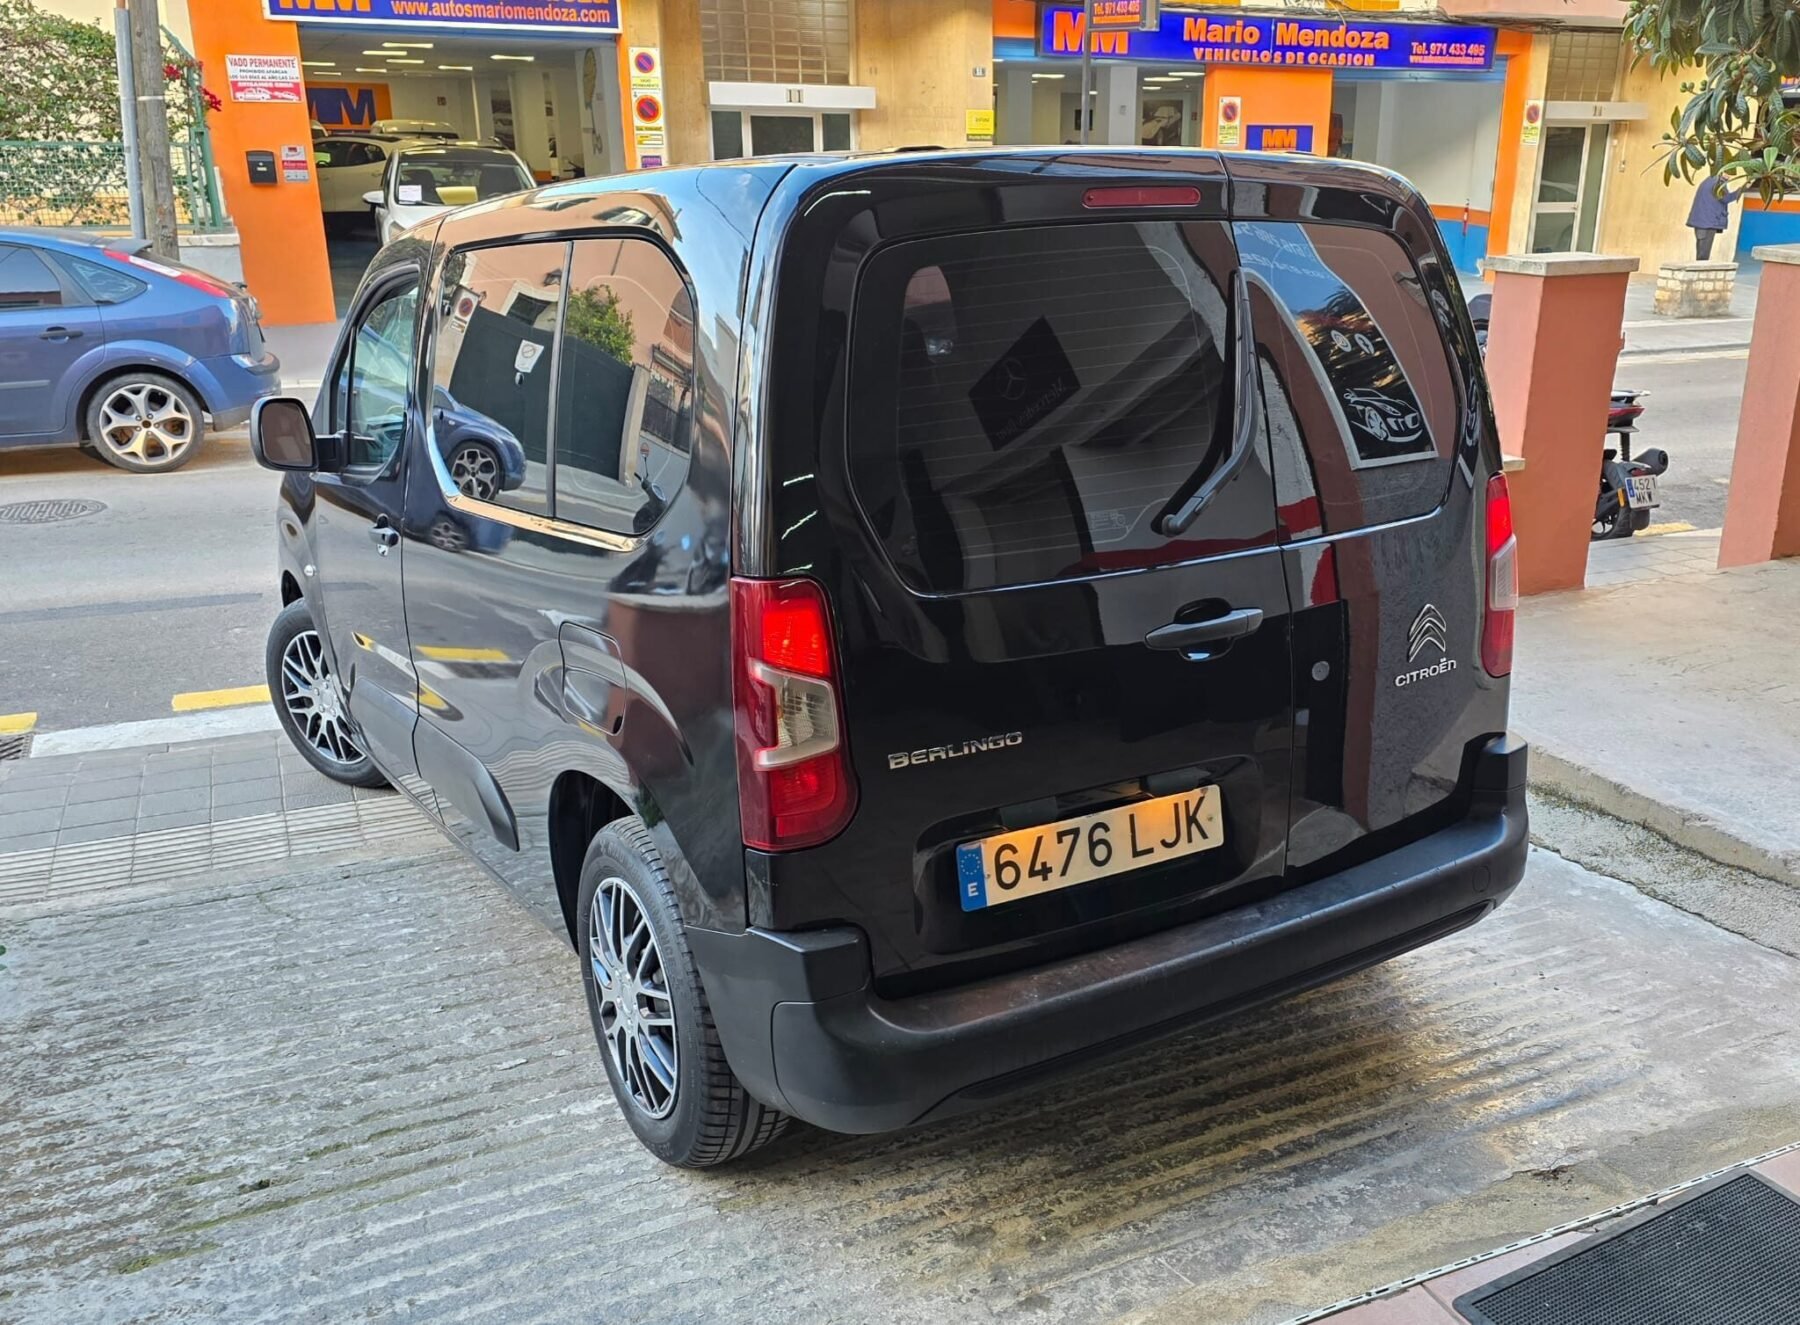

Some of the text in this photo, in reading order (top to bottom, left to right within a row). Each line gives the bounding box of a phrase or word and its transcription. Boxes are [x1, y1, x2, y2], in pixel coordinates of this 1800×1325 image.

[390, 1, 611, 23] www.autosmariomendoza.com
[1183, 17, 1389, 49] Mario Mendoza
[1193, 47, 1375, 66] VEHICULOS DE OCASION
[1411, 42, 1428, 54] Tel.
[1430, 42, 1447, 55] 971
[228, 57, 296, 69] VADO PERMANENTE
[1262, 129, 1297, 148] MM
[888, 731, 1023, 770] BERLINGO
[994, 796, 1209, 890] 6476 LJK
[967, 882, 978, 897] E
